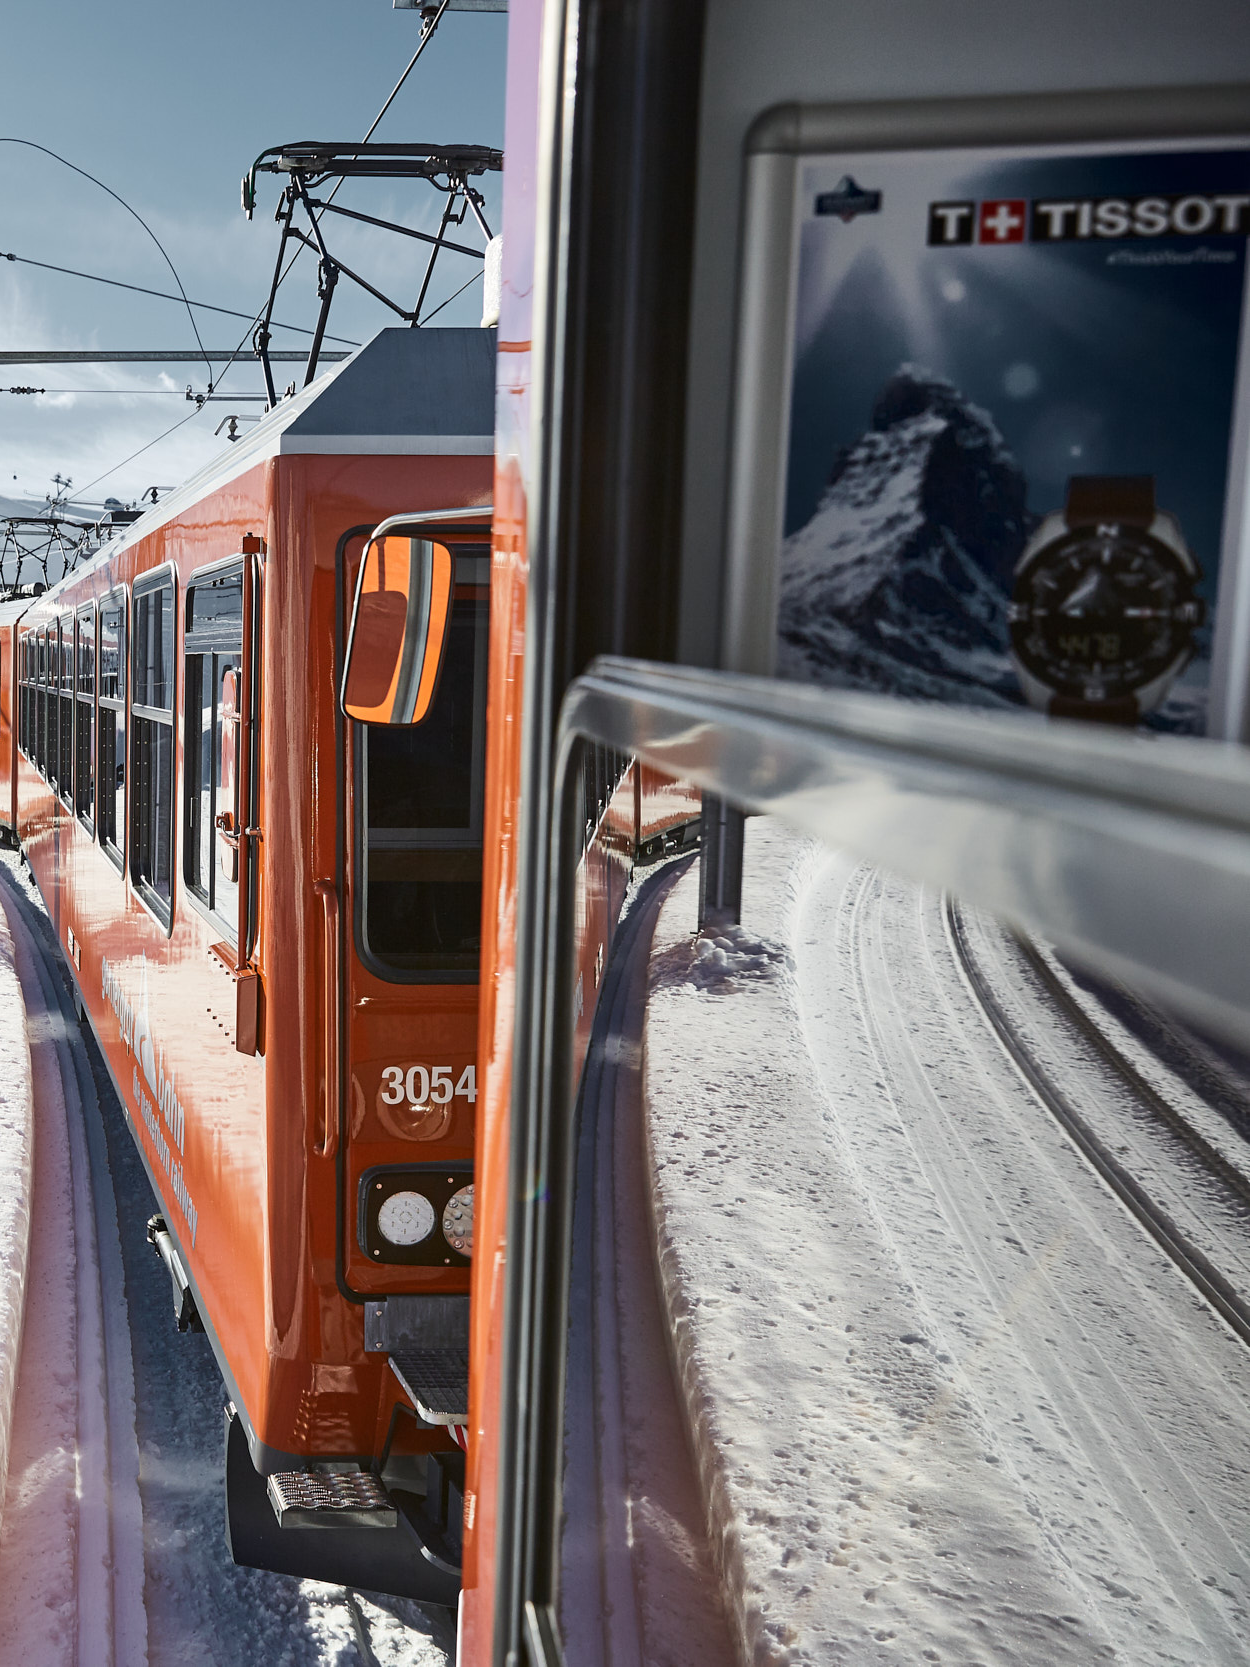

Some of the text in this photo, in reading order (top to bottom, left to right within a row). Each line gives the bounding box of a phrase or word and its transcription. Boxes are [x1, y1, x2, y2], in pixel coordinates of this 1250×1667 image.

[934, 196, 1250, 242] T TISSOT
[158, 1047, 185, 1157] bahn
[381, 1065, 478, 1105] 3054
[140, 1089, 170, 1177] matterhorn
[170, 1156, 198, 1250] railway
